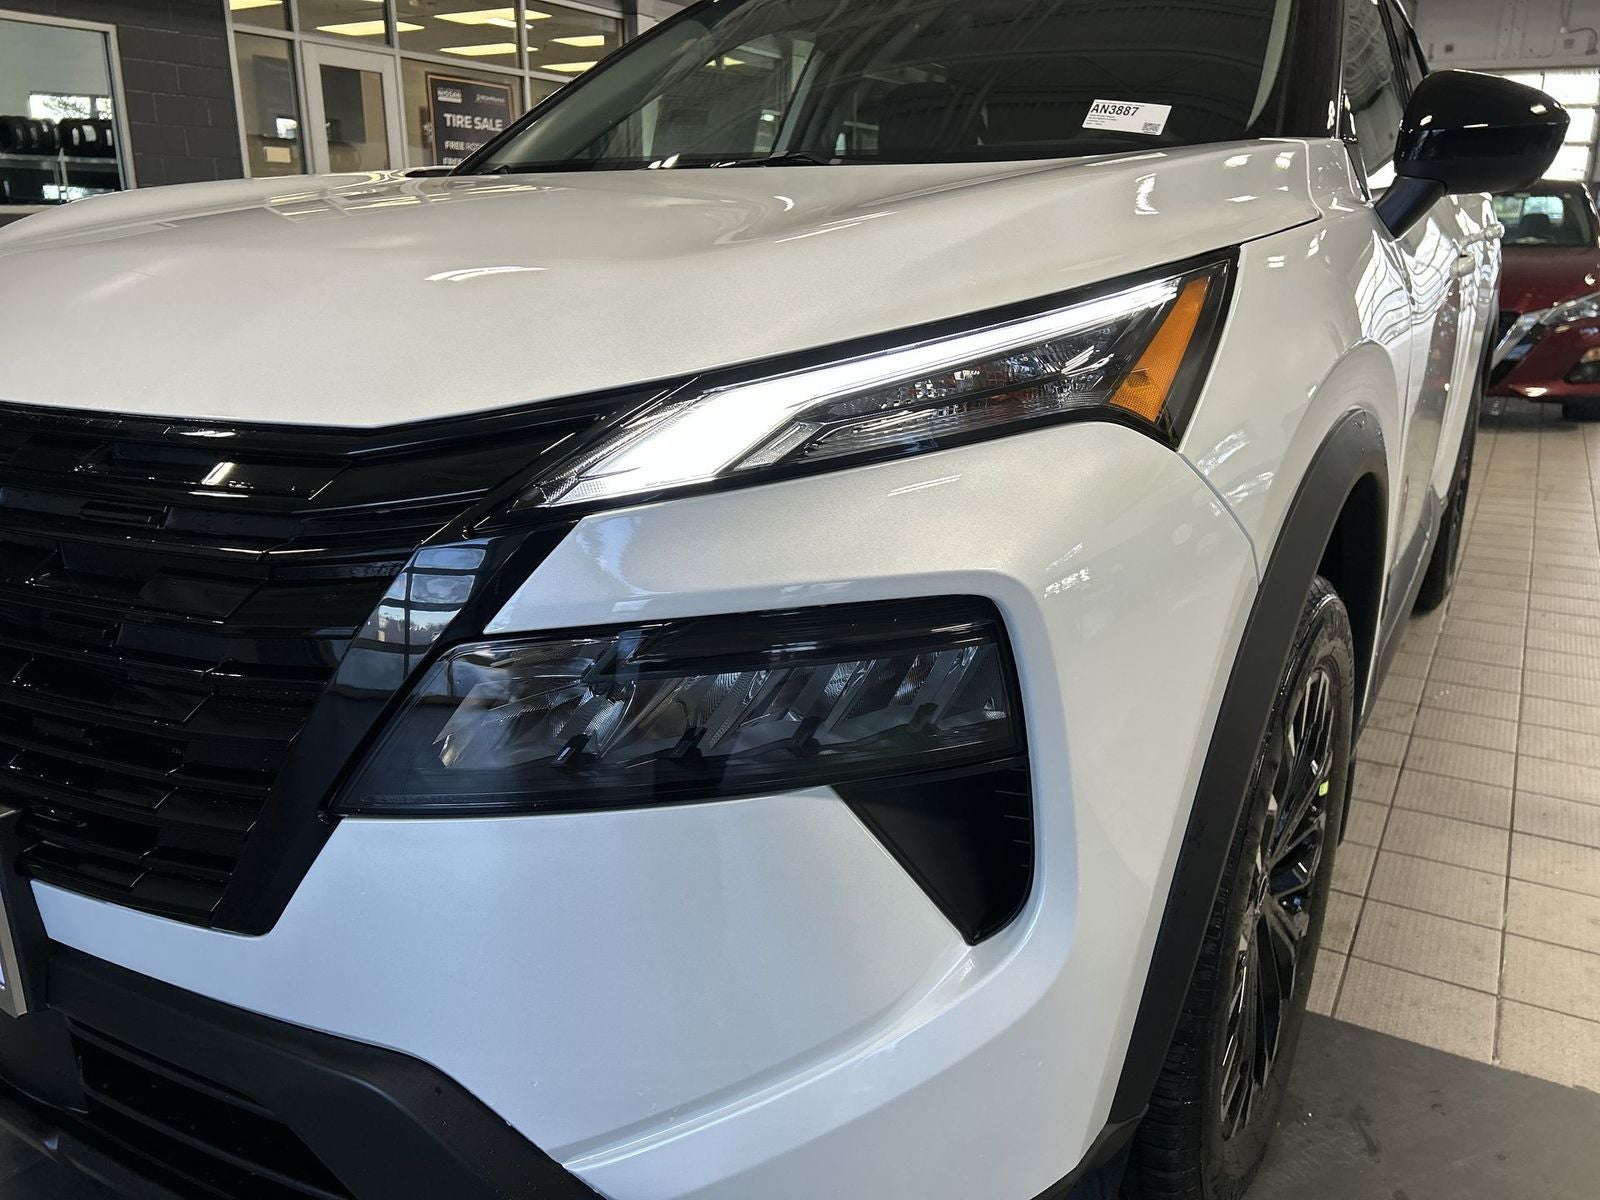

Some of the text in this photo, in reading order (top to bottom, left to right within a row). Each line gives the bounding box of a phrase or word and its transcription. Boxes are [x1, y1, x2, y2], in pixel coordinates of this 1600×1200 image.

[1091, 104, 1139, 116] AN3887
[443, 113, 503, 132] TIRE SALE
[444, 140, 465, 151] FREE
